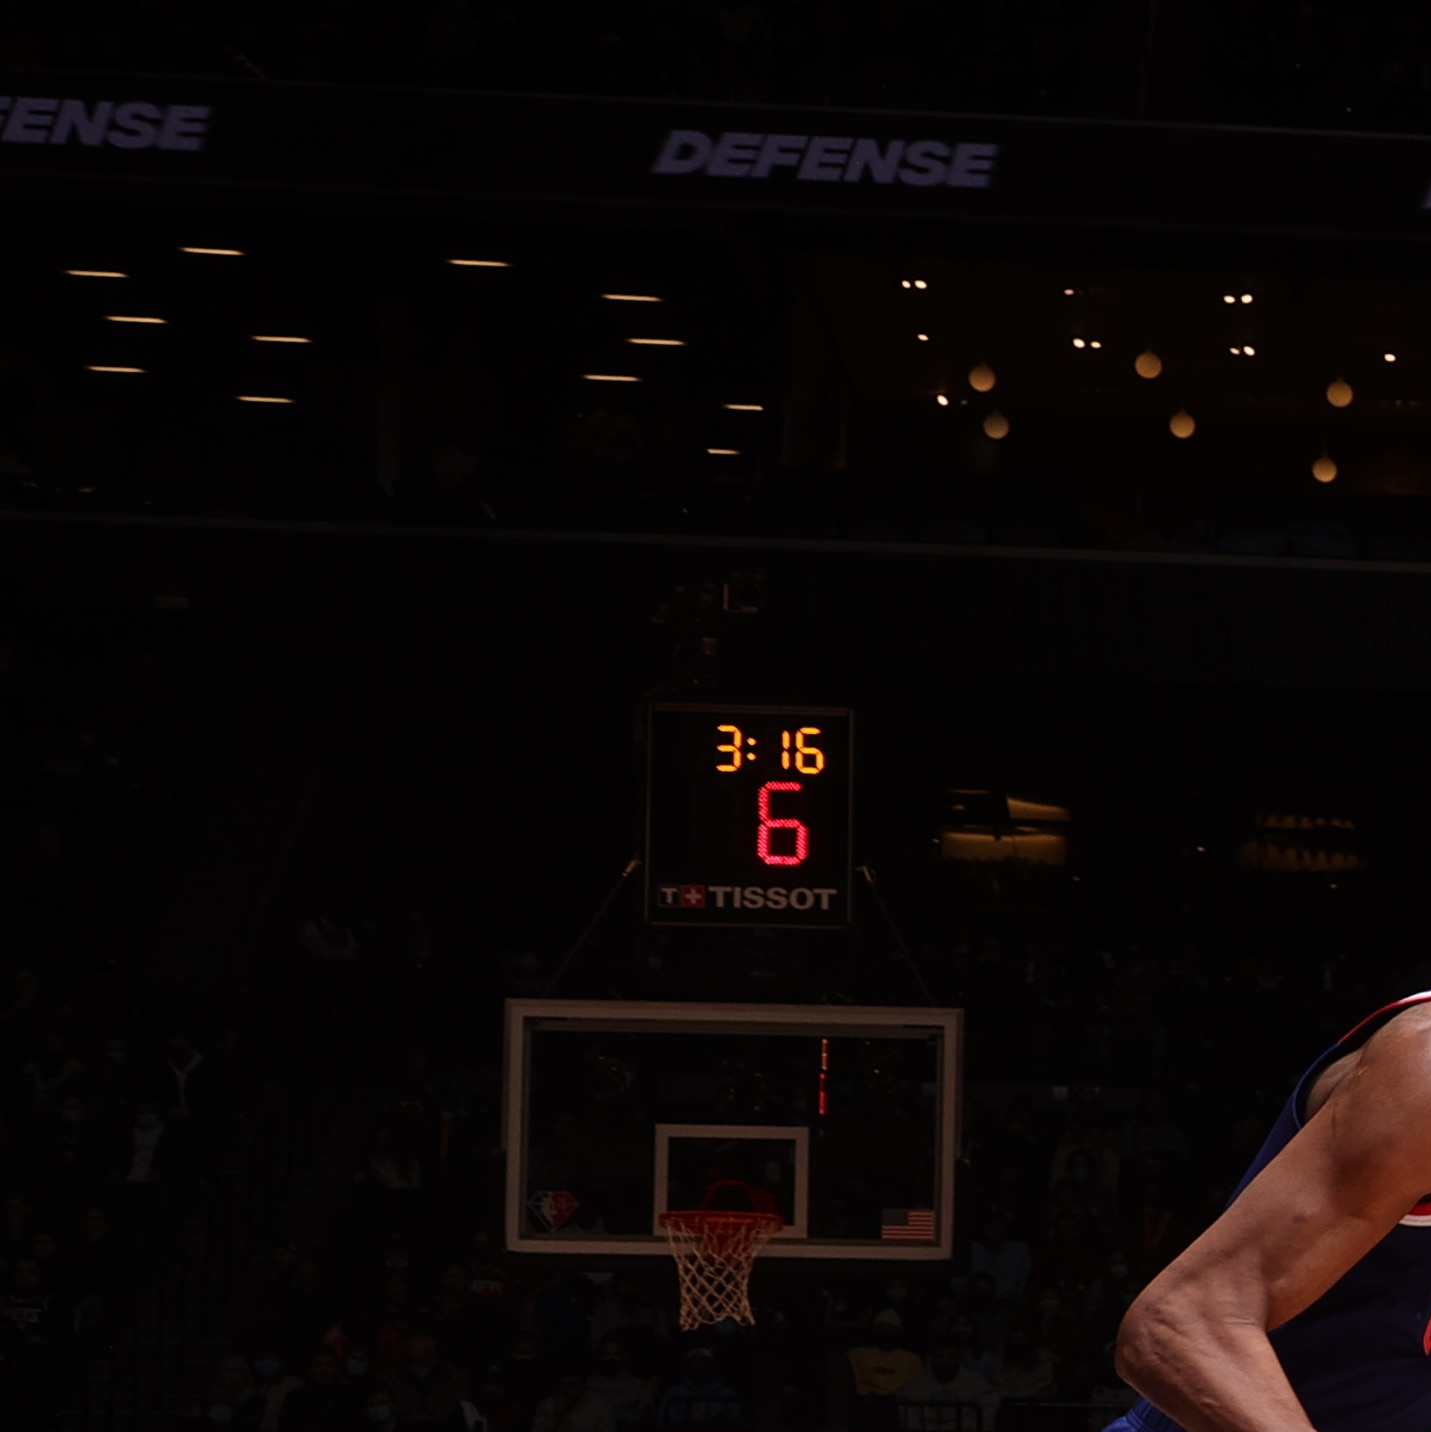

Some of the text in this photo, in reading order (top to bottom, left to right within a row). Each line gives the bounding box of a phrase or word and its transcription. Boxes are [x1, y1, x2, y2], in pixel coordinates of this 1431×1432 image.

[652, 130, 1000, 188] DEFENSE
[715, 723, 827, 776] 3:16
[755, 780, 809, 867] 6
[707, 885, 838, 911] TISSOT
